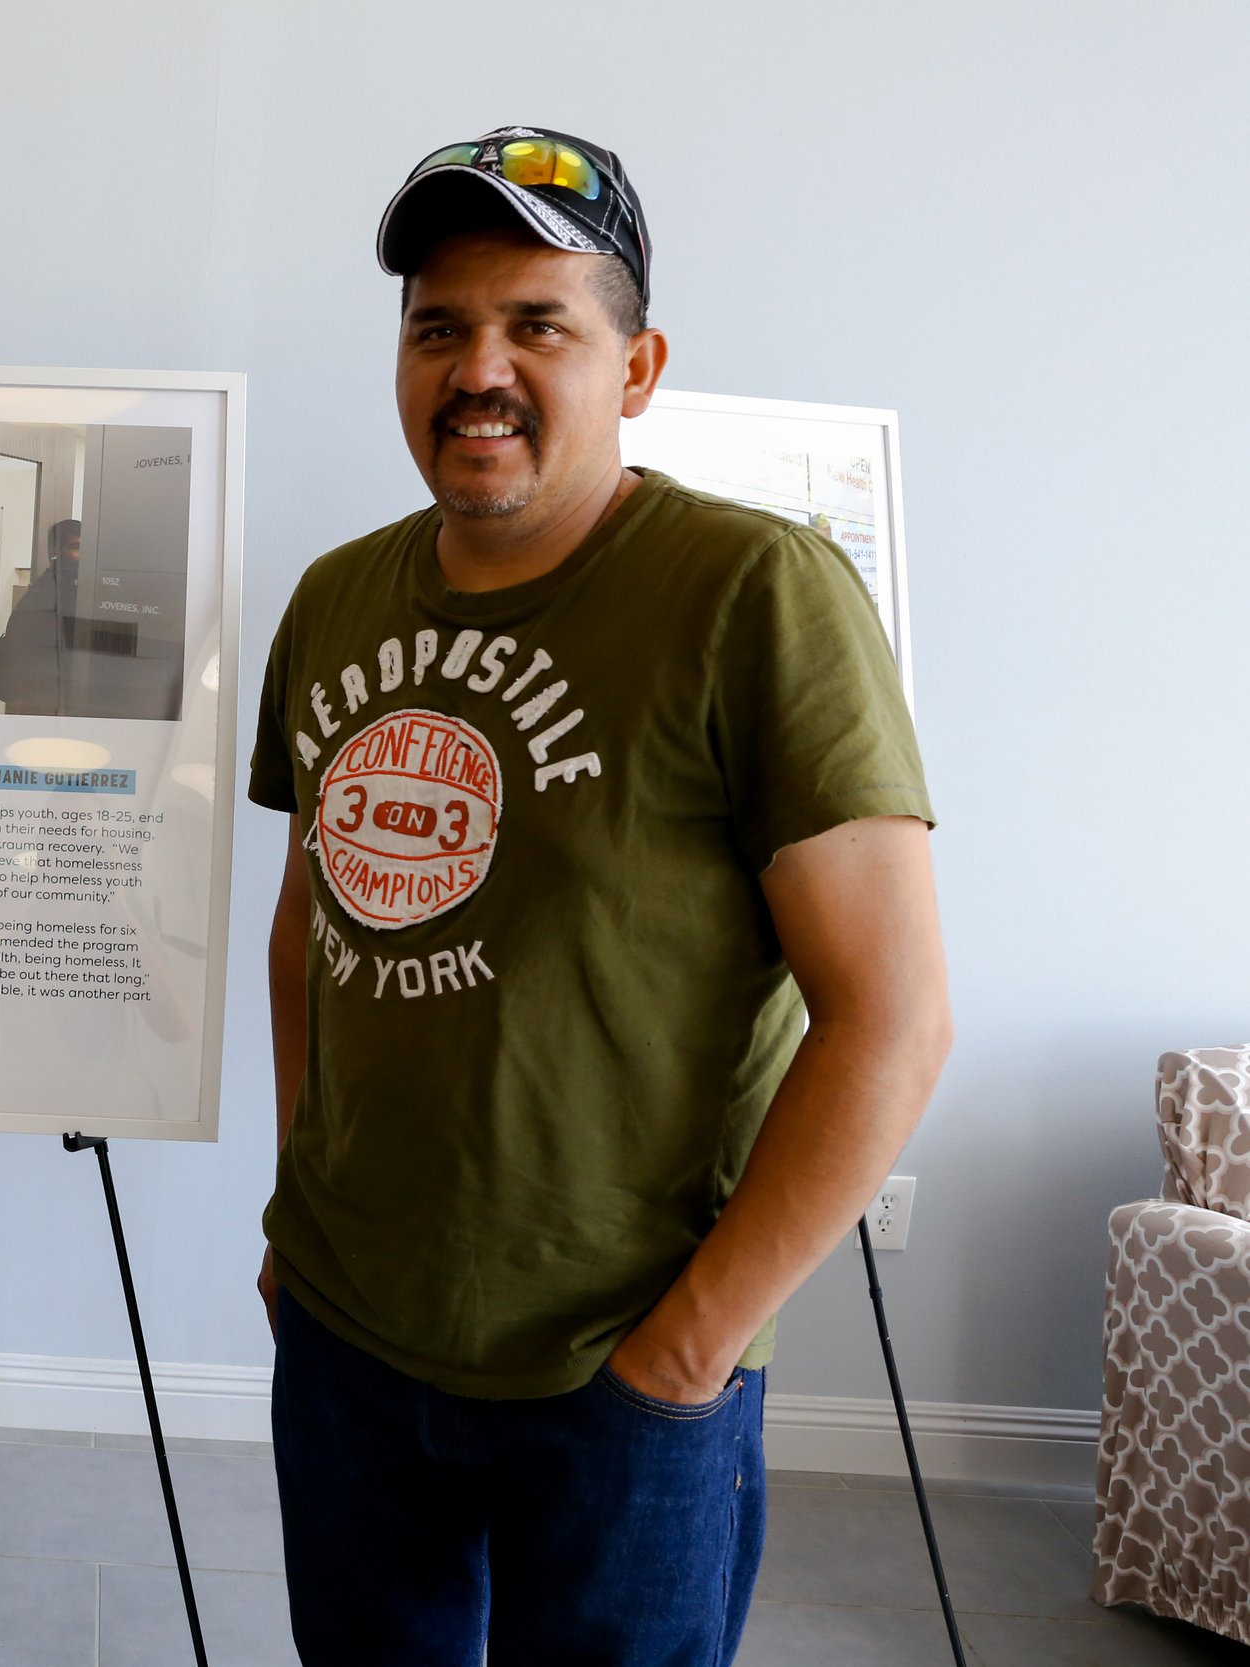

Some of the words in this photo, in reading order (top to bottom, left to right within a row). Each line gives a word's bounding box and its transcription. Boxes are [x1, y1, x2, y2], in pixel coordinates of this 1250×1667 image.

[134, 455, 183, 469] JOVENES,
[100, 601, 139, 613] JOVENES,
[142, 605, 161, 615] INC.
[345, 718, 493, 795] CONFERENCE
[44, 772, 129, 788] GUTIERREZ
[61, 810, 93, 824] ages
[138, 809, 164, 823] end
[335, 784, 369, 833] 3
[386, 805, 427, 832] ON
[438, 800, 470, 851] 3
[6, 821, 34, 835] their
[38, 822, 77, 836] needs
[81, 823, 98, 837] for
[10, 869, 39, 887] help
[42, 870, 102, 886] homeless
[105, 873, 142, 891] youth
[330, 848, 479, 909] CHAMPIONS
[11, 889, 32, 899] our
[36, 918, 96, 934] homeless
[100, 921, 116, 935] for
[120, 922, 137, 935] six
[313, 900, 361, 986] NEW
[373, 940, 495, 1000] YORK
